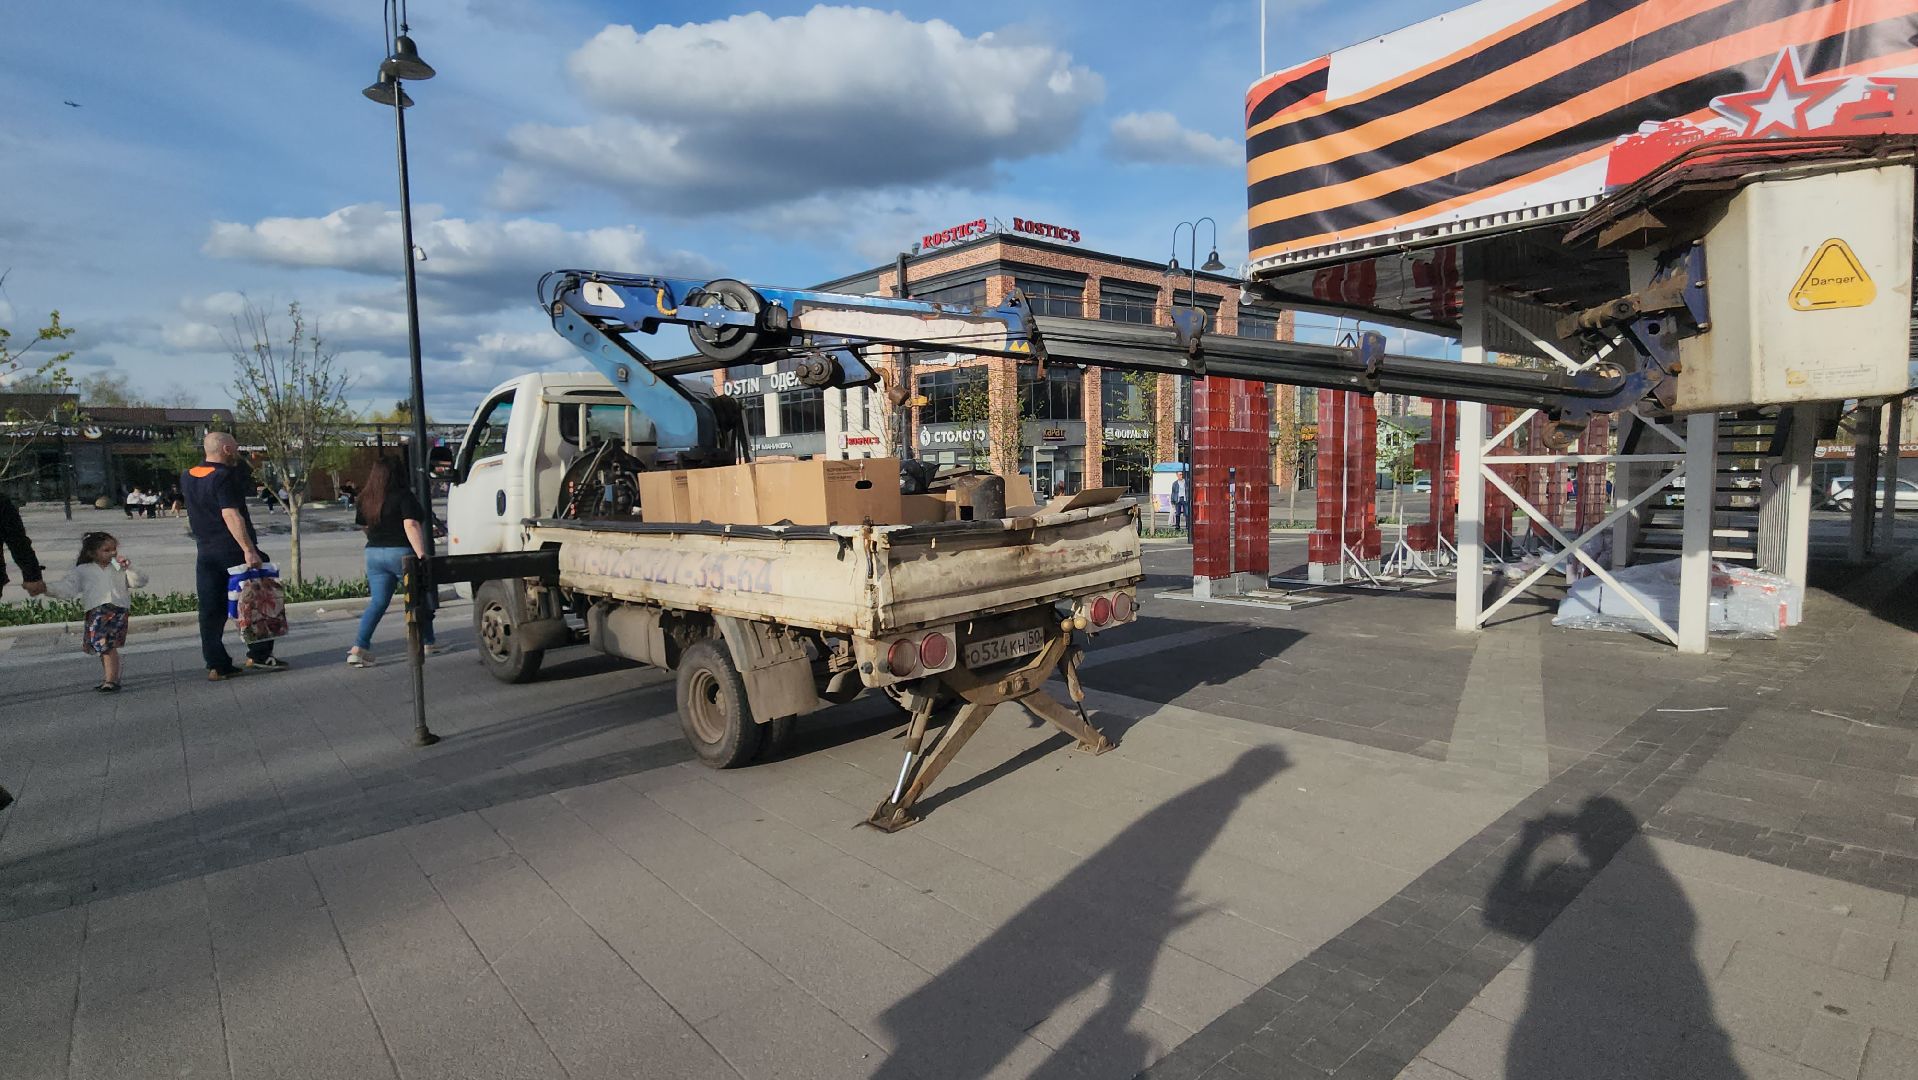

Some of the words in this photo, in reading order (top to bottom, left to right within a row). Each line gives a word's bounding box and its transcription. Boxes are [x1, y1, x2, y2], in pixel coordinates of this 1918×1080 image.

[922, 218, 987, 249] ROSTIC'S
[1013, 217, 1080, 243] ROSTIC'S
[1811, 275, 1856, 286] Danger
[1028, 630, 1040, 645] 50
